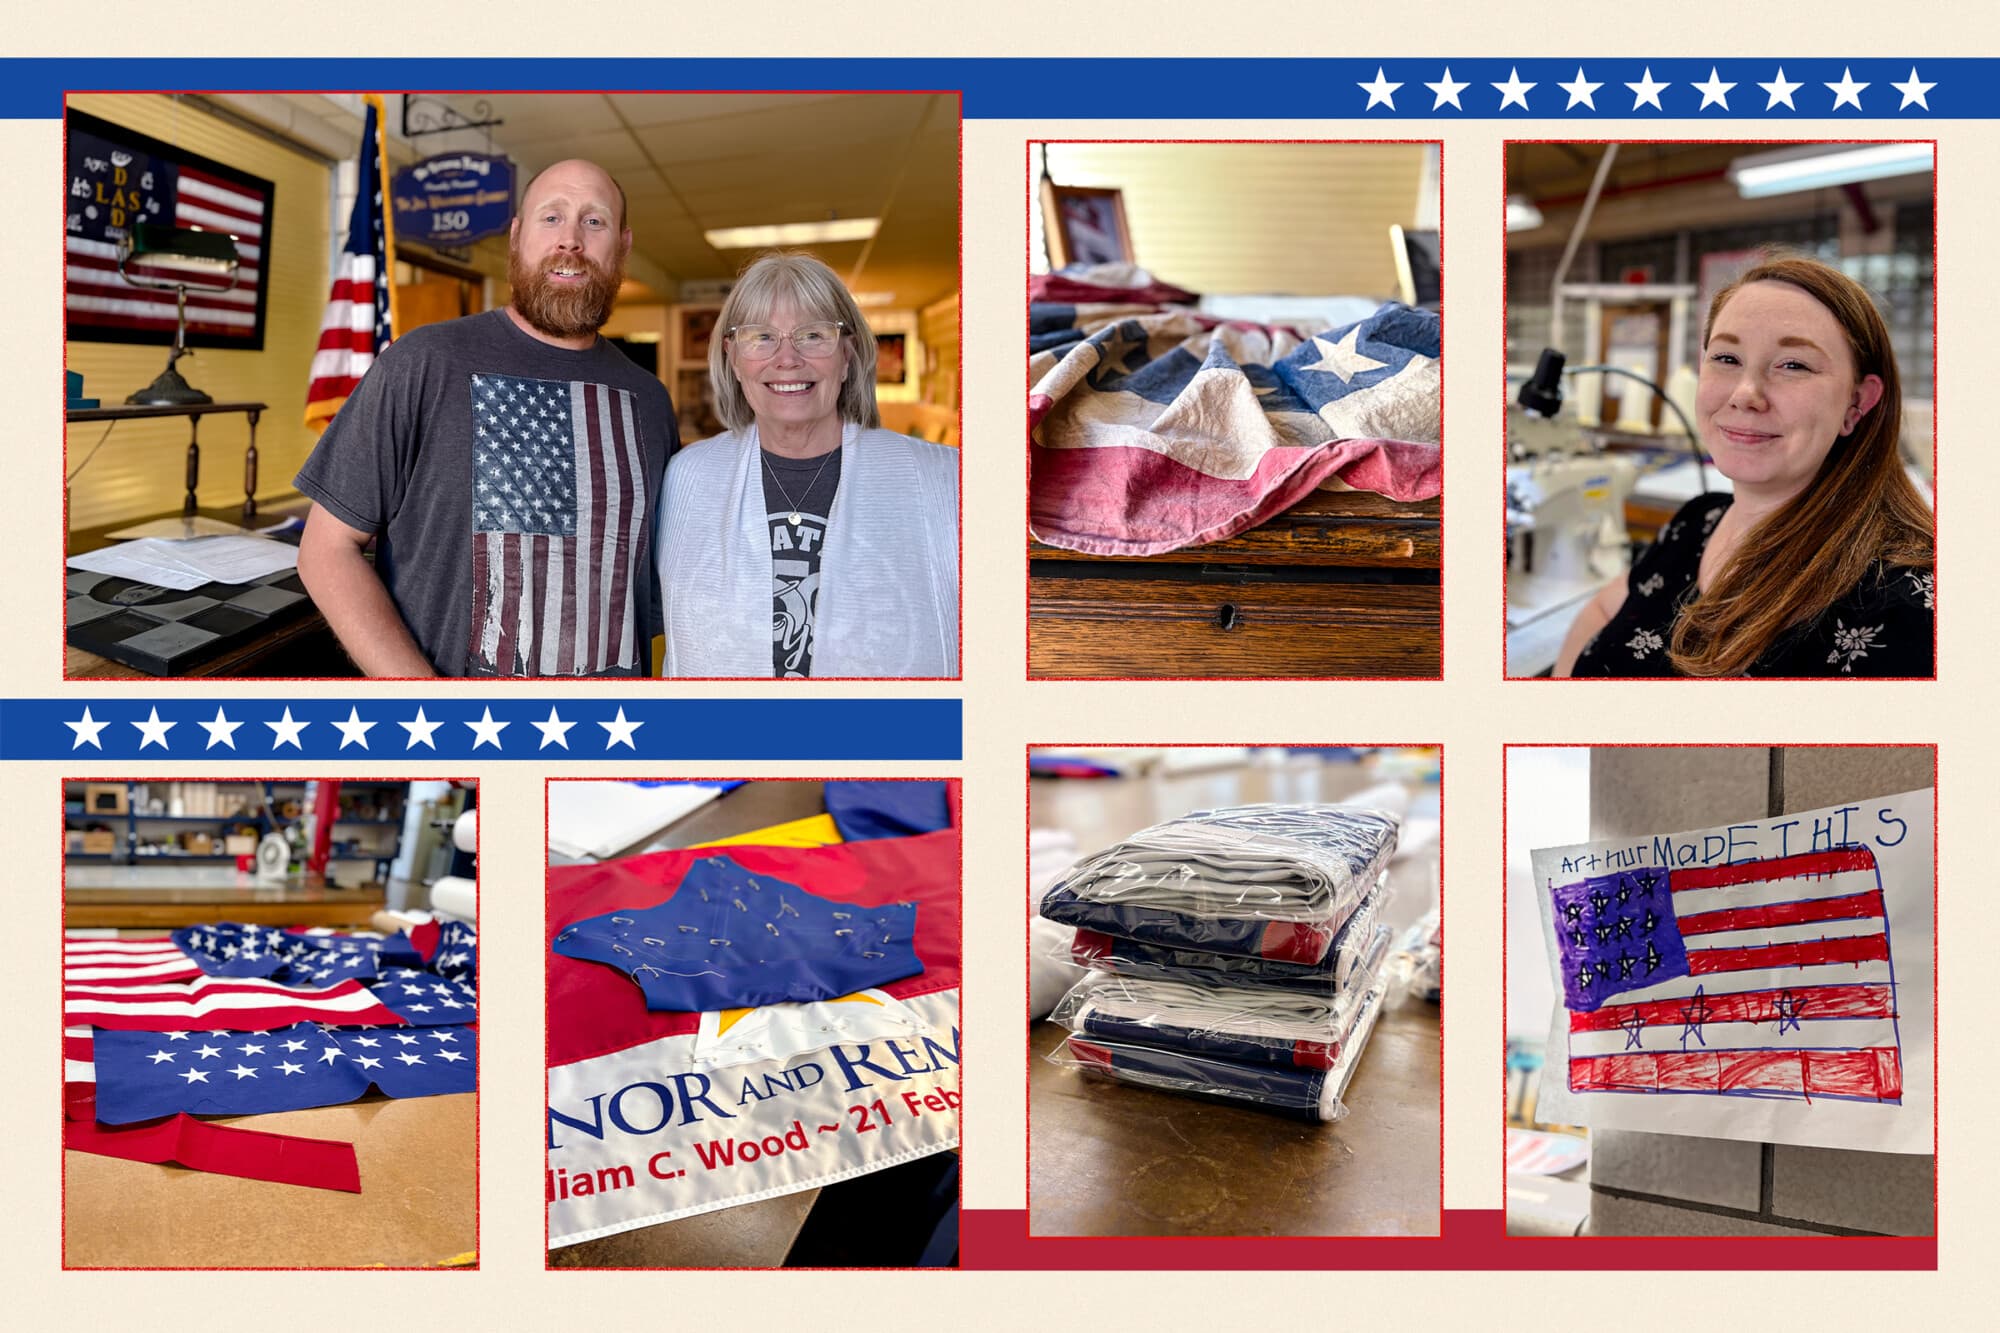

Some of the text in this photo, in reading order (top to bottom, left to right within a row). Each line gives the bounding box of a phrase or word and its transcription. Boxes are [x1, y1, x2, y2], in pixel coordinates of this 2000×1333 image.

[432, 210, 470, 231] 150
[737, 1063, 825, 1105] AND
[648, 1152, 686, 1180] C.
[693, 1120, 809, 1170] Wood
[849, 1098, 892, 1134] 21
[901, 1087, 959, 1117] Feb
